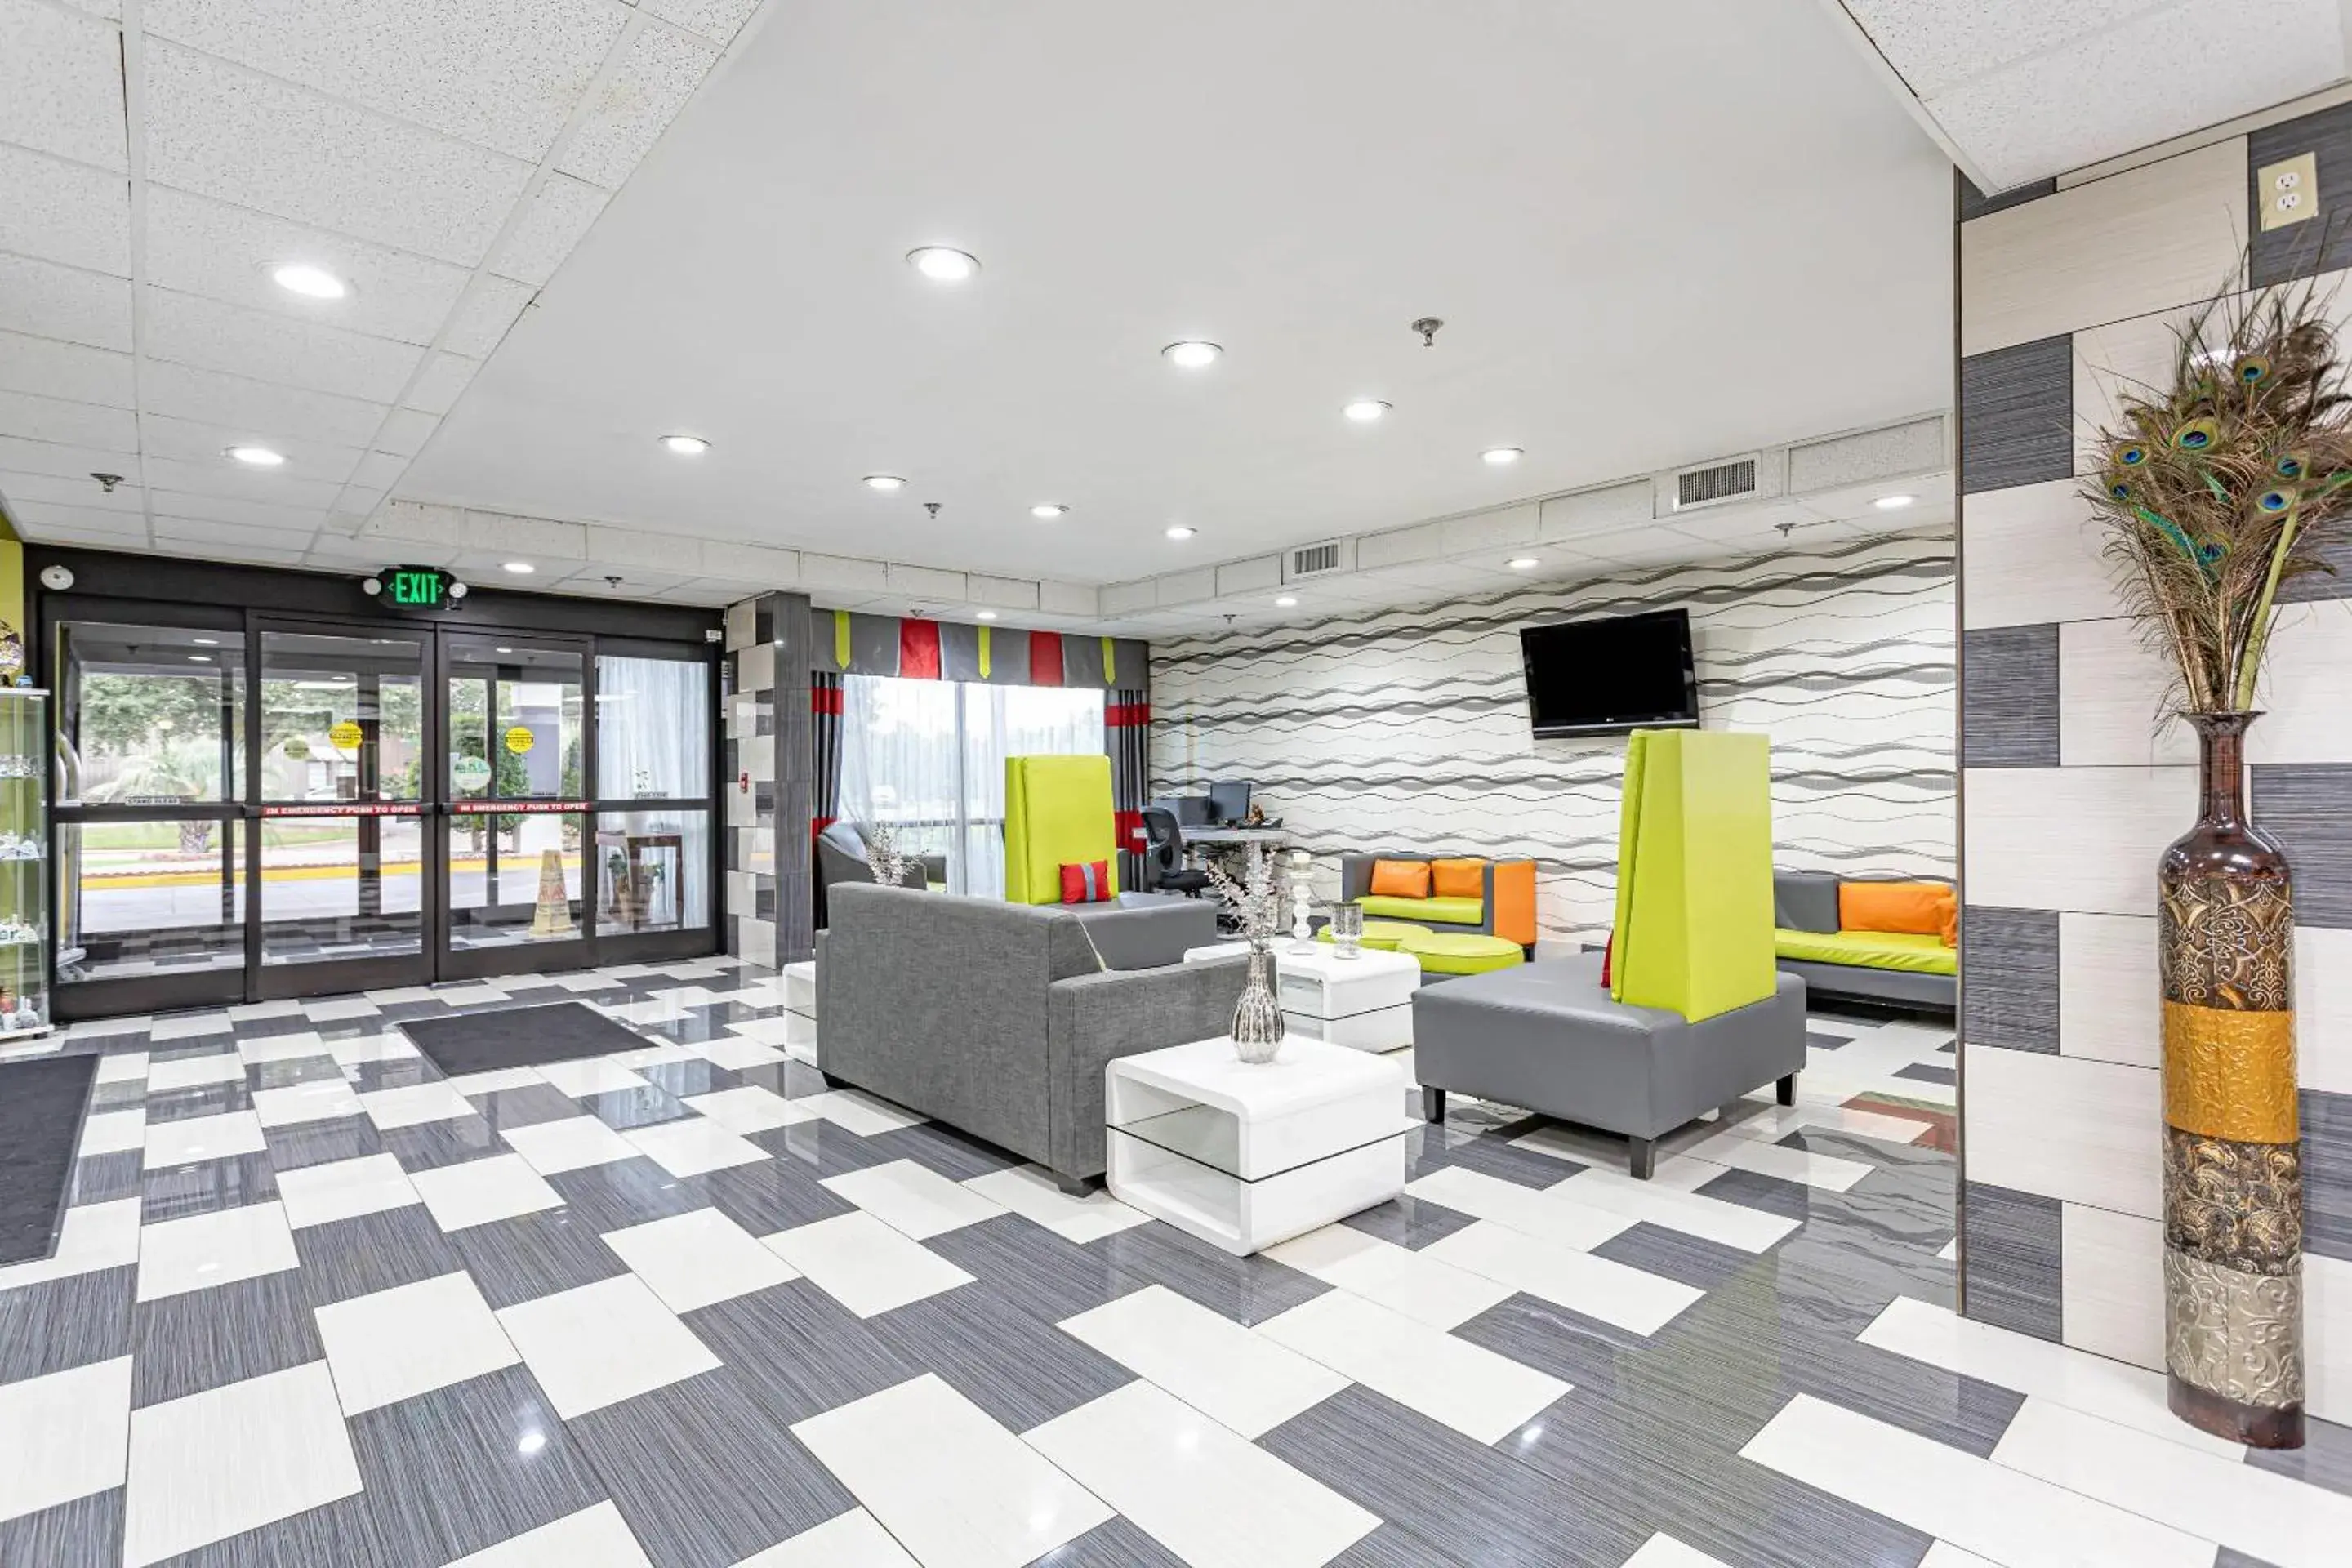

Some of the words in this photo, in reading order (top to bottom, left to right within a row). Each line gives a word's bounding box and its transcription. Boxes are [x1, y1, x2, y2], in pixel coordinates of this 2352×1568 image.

[395, 572, 439, 603] EXIT
[266, 806, 278, 815] IN
[280, 805, 345, 815] EMERGENCY
[346, 804, 373, 814] PUSH
[375, 804, 389, 813] TO
[390, 804, 416, 813] OPEN
[460, 804, 471, 812] IN
[474, 803, 524, 812] EMERGENCY
[526, 803, 550, 811] PUSH
[564, 802, 587, 811] OPEN
